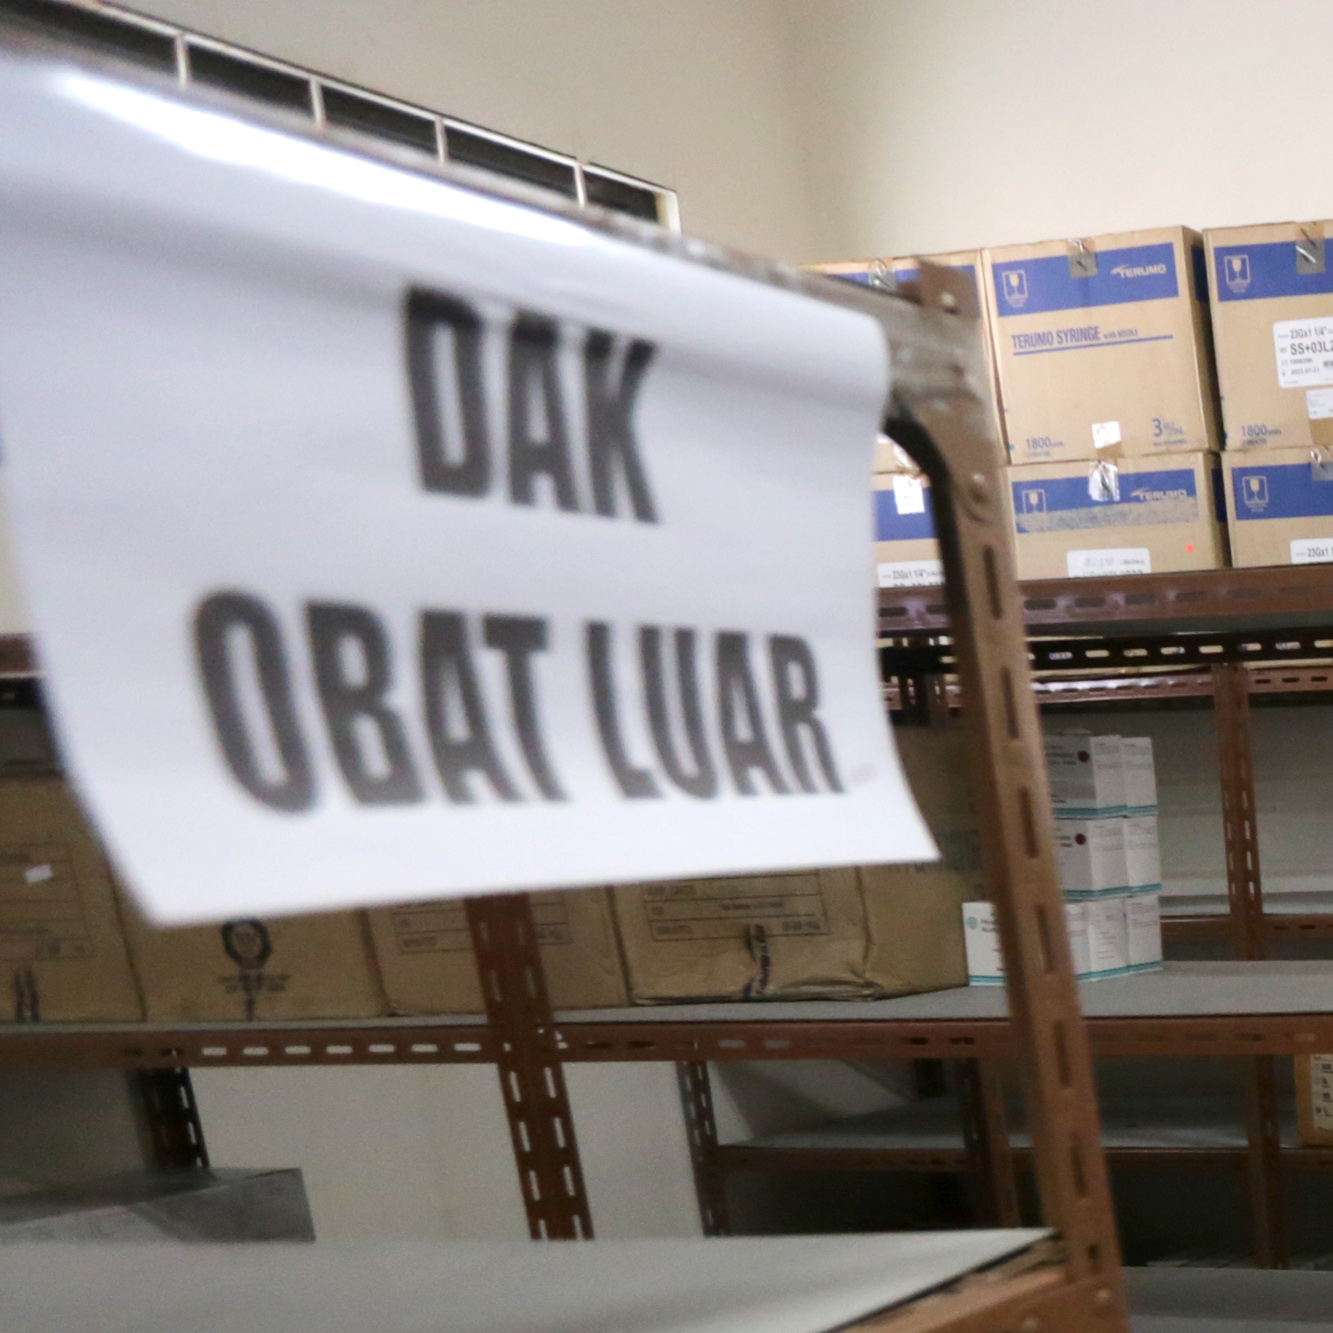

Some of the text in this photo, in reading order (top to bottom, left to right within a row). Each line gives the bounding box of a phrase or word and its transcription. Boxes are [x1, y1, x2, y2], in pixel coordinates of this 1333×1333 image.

[1118, 263, 1167, 279] TERUMO
[1011, 330, 1054, 350] TERUMO
[1056, 326, 1100, 346] SYRINGE
[405, 283, 660, 524] DAK
[1152, 417, 1164, 438] 3
[1240, 424, 1267, 437] 1800
[1025, 436, 1050, 450] 1800
[1138, 488, 1188, 501] TERUMO
[190, 587, 847, 817] OBAT LUAR
